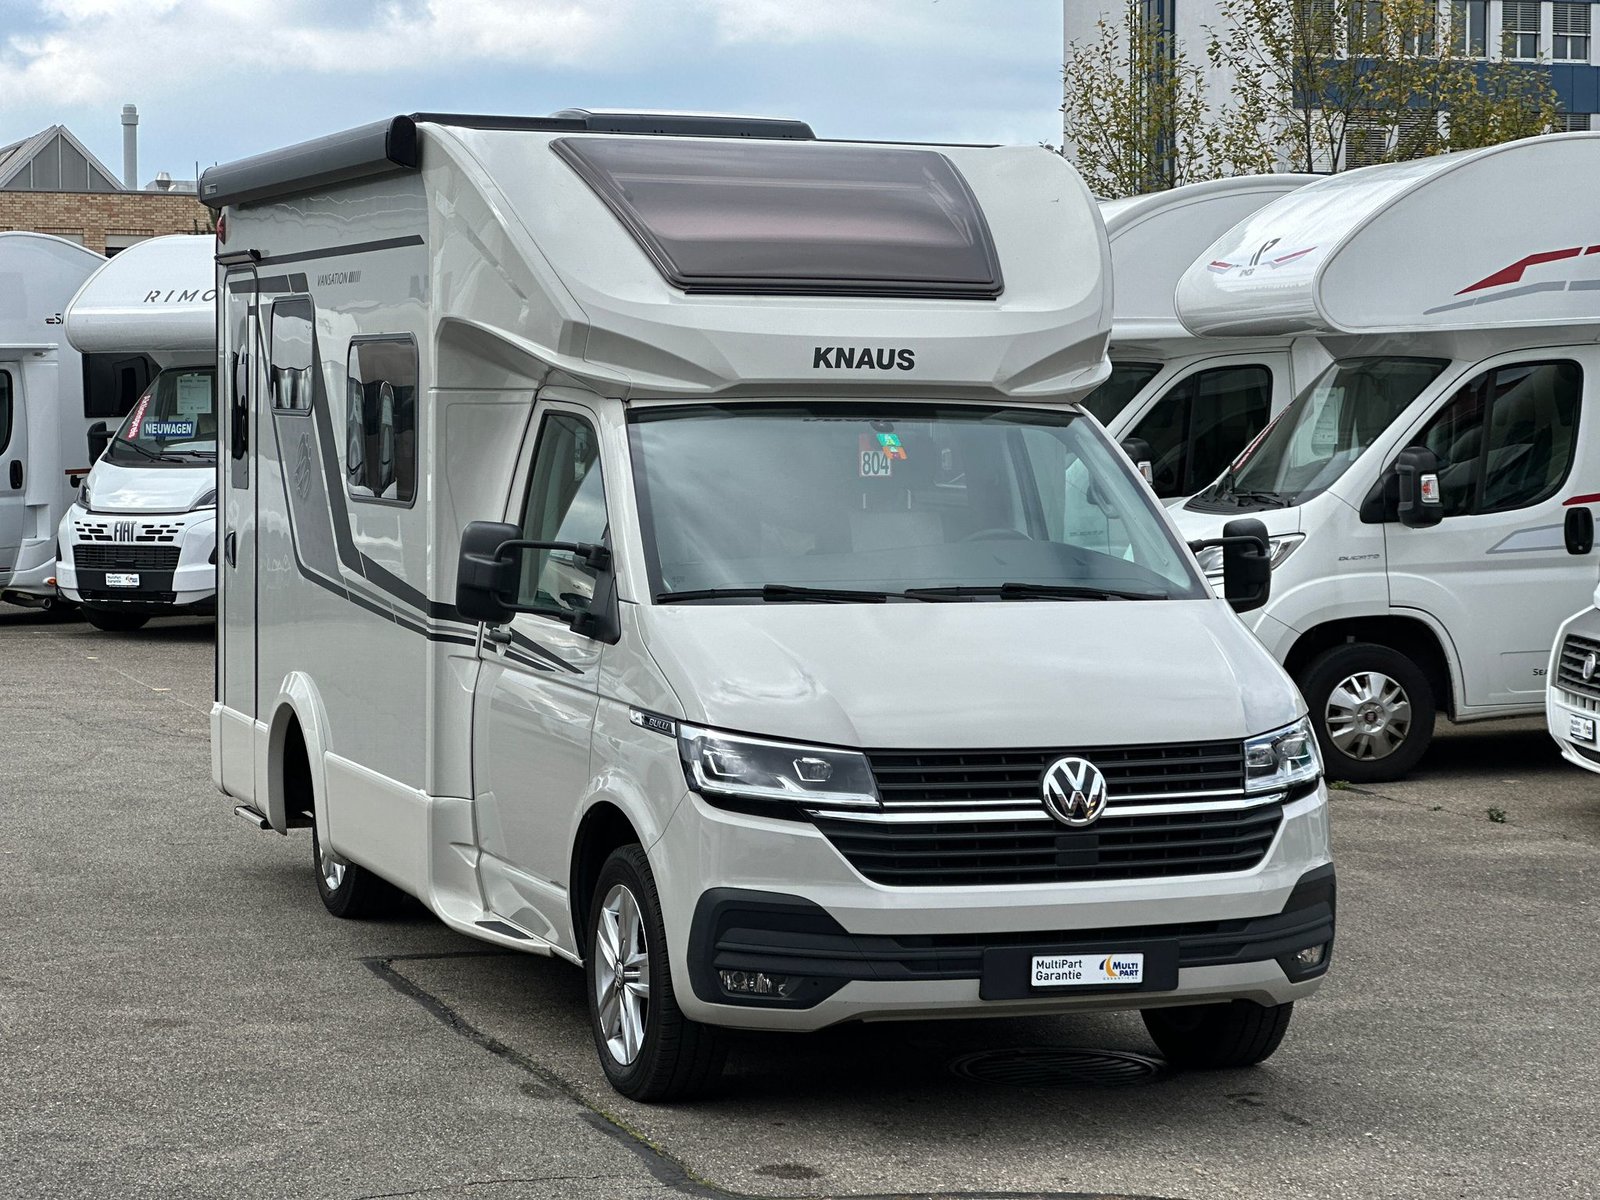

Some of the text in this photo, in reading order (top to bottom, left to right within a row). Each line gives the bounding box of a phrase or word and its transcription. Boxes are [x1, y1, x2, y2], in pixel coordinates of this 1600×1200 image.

[317, 271, 349, 287] VANSATION
[813, 347, 915, 371] KNAUS
[145, 423, 192, 435] NEUWAGEN
[862, 451, 890, 475] 804
[114, 520, 137, 542] FIAT
[1338, 553, 1380, 561] DUCATO
[1043, 757, 1107, 824] VW
[1036, 959, 1083, 970] MultiPart
[1112, 961, 1138, 970] MULTI
[1036, 970, 1082, 981] Garantie
[1119, 969, 1139, 977] PART
